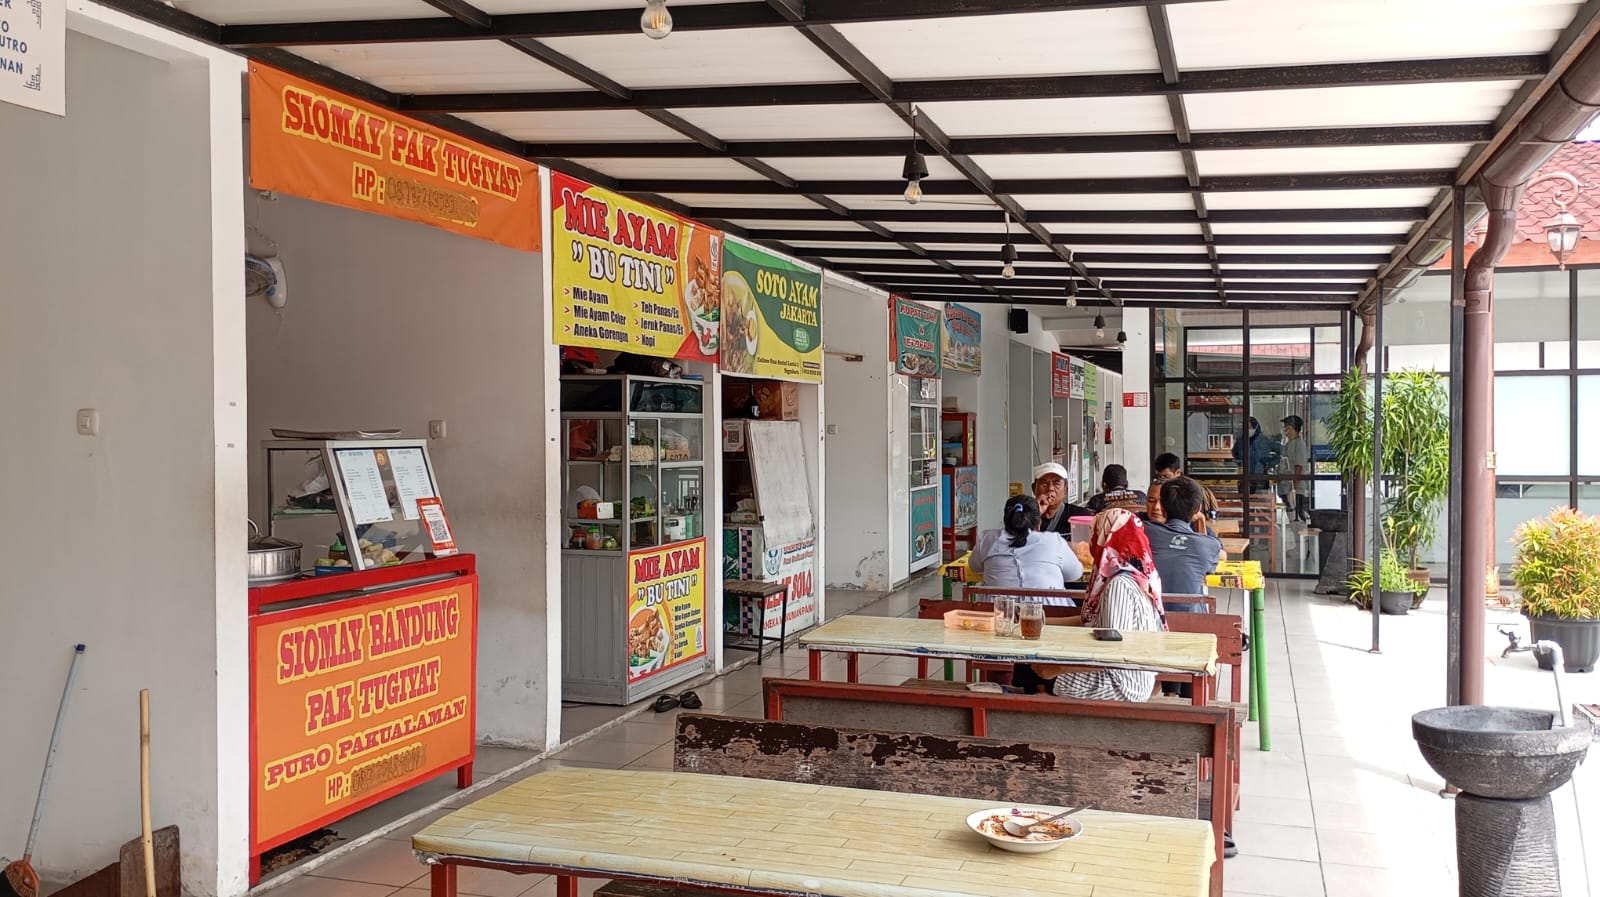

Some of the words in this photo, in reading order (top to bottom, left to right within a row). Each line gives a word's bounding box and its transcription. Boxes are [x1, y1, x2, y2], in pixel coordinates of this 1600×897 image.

[284, 88, 387, 158] SIOMAY
[391, 123, 438, 174] PAK
[442, 140, 522, 201] TUGIYAT
[563, 188, 610, 241] MIE
[613, 209, 678, 261] AYAM
[573, 287, 588, 301] Mie
[588, 290, 609, 304] Ayam
[756, 269, 787, 300] SOTO
[788, 279, 819, 308] AYAM
[573, 305, 588, 319] Mie
[589, 308, 610, 322] Ayam
[641, 301, 653, 314] Teh
[653, 304, 679, 319] Panas/Es
[641, 318, 658, 332] Jeruk
[780, 303, 818, 327] JAKARTA
[574, 323, 598, 338] Aneka
[641, 334, 656, 348] Kopi
[634, 555, 661, 584] MIE
[663, 547, 701, 577] AYAM
[280, 617, 363, 680] SIOMAY
[370, 597, 459, 657] BANDUNG
[308, 685, 353, 731] PAK
[360, 660, 439, 714] TUGIYAT
[268, 748, 331, 785] PURO
[339, 699, 466, 760] PAKUALAMAN
